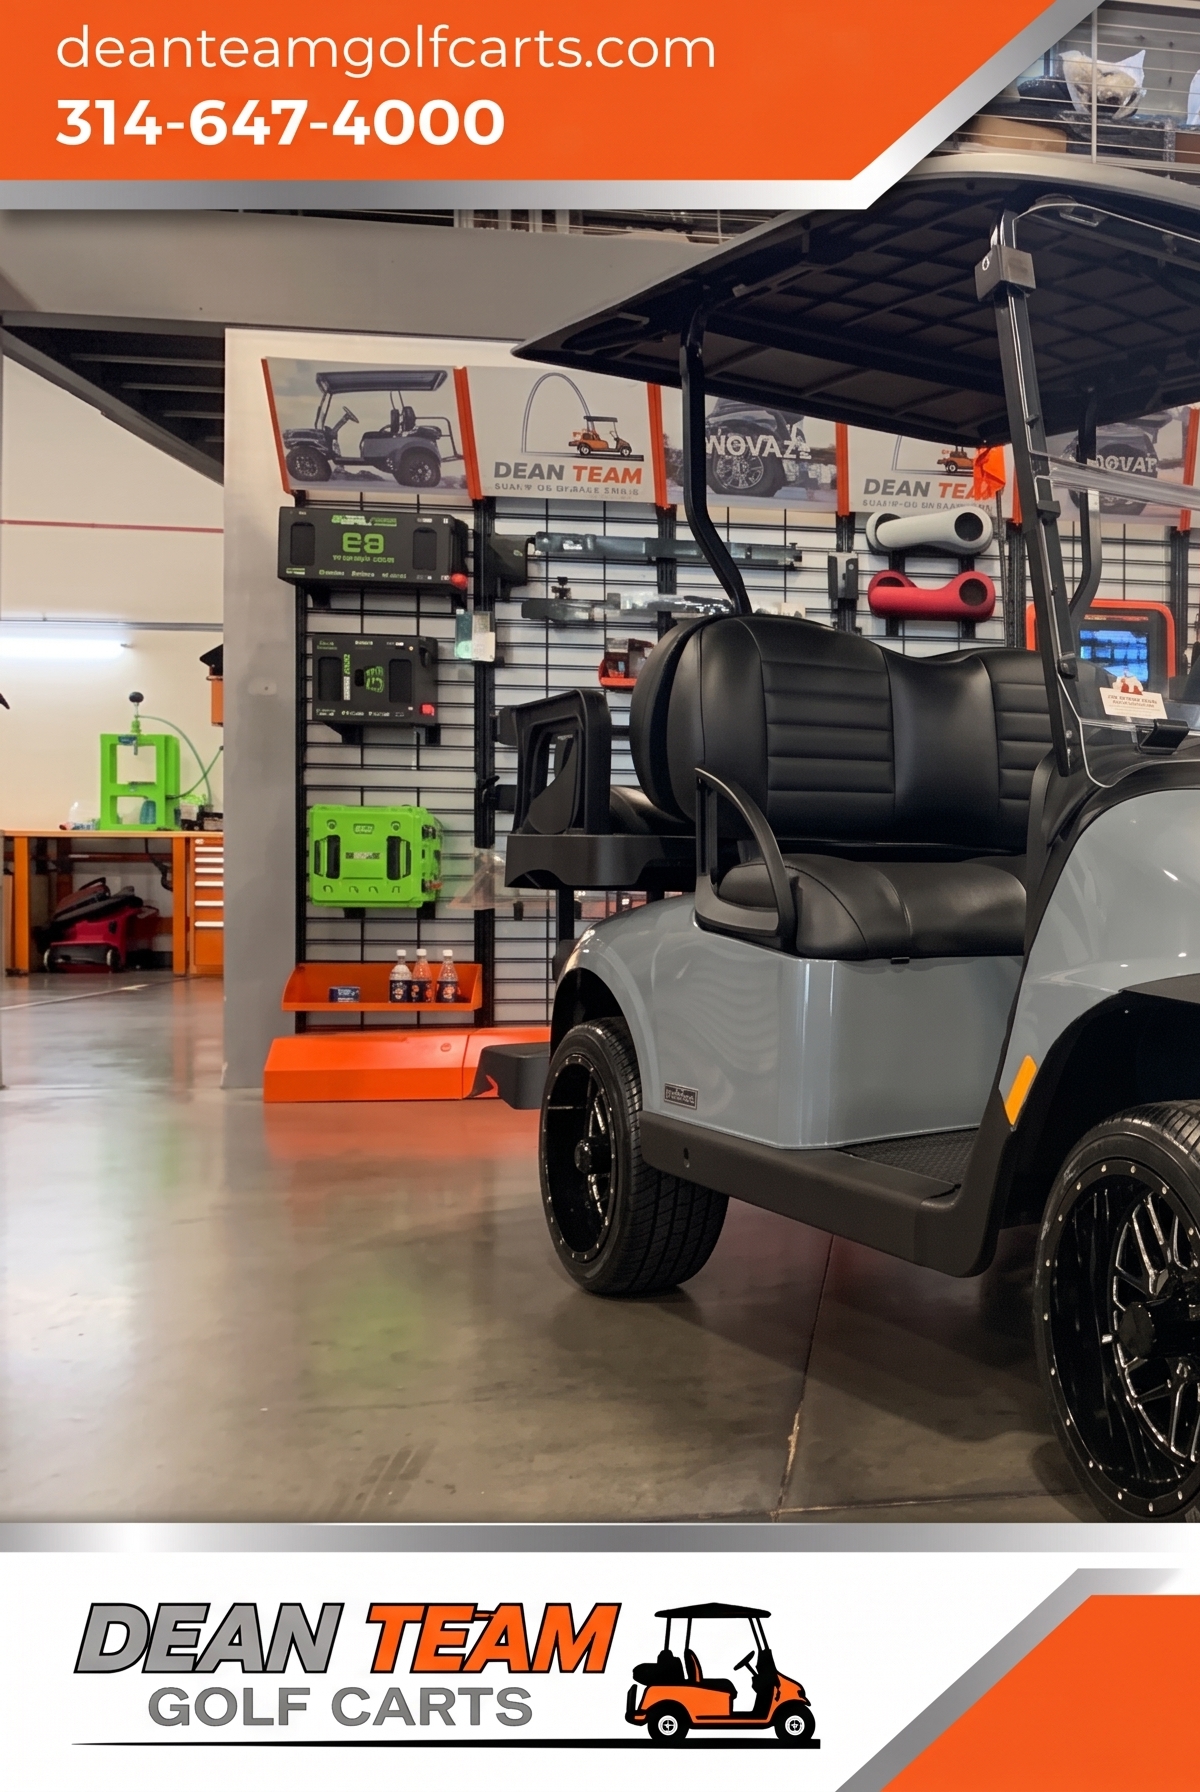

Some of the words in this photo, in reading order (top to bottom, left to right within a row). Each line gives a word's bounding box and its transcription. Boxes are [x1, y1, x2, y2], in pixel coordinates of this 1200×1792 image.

[493, 461, 565, 481] DEAN
[572, 464, 643, 485] TEAM
[863, 478, 931, 498] DEAN
[938, 482, 993, 500] TE
